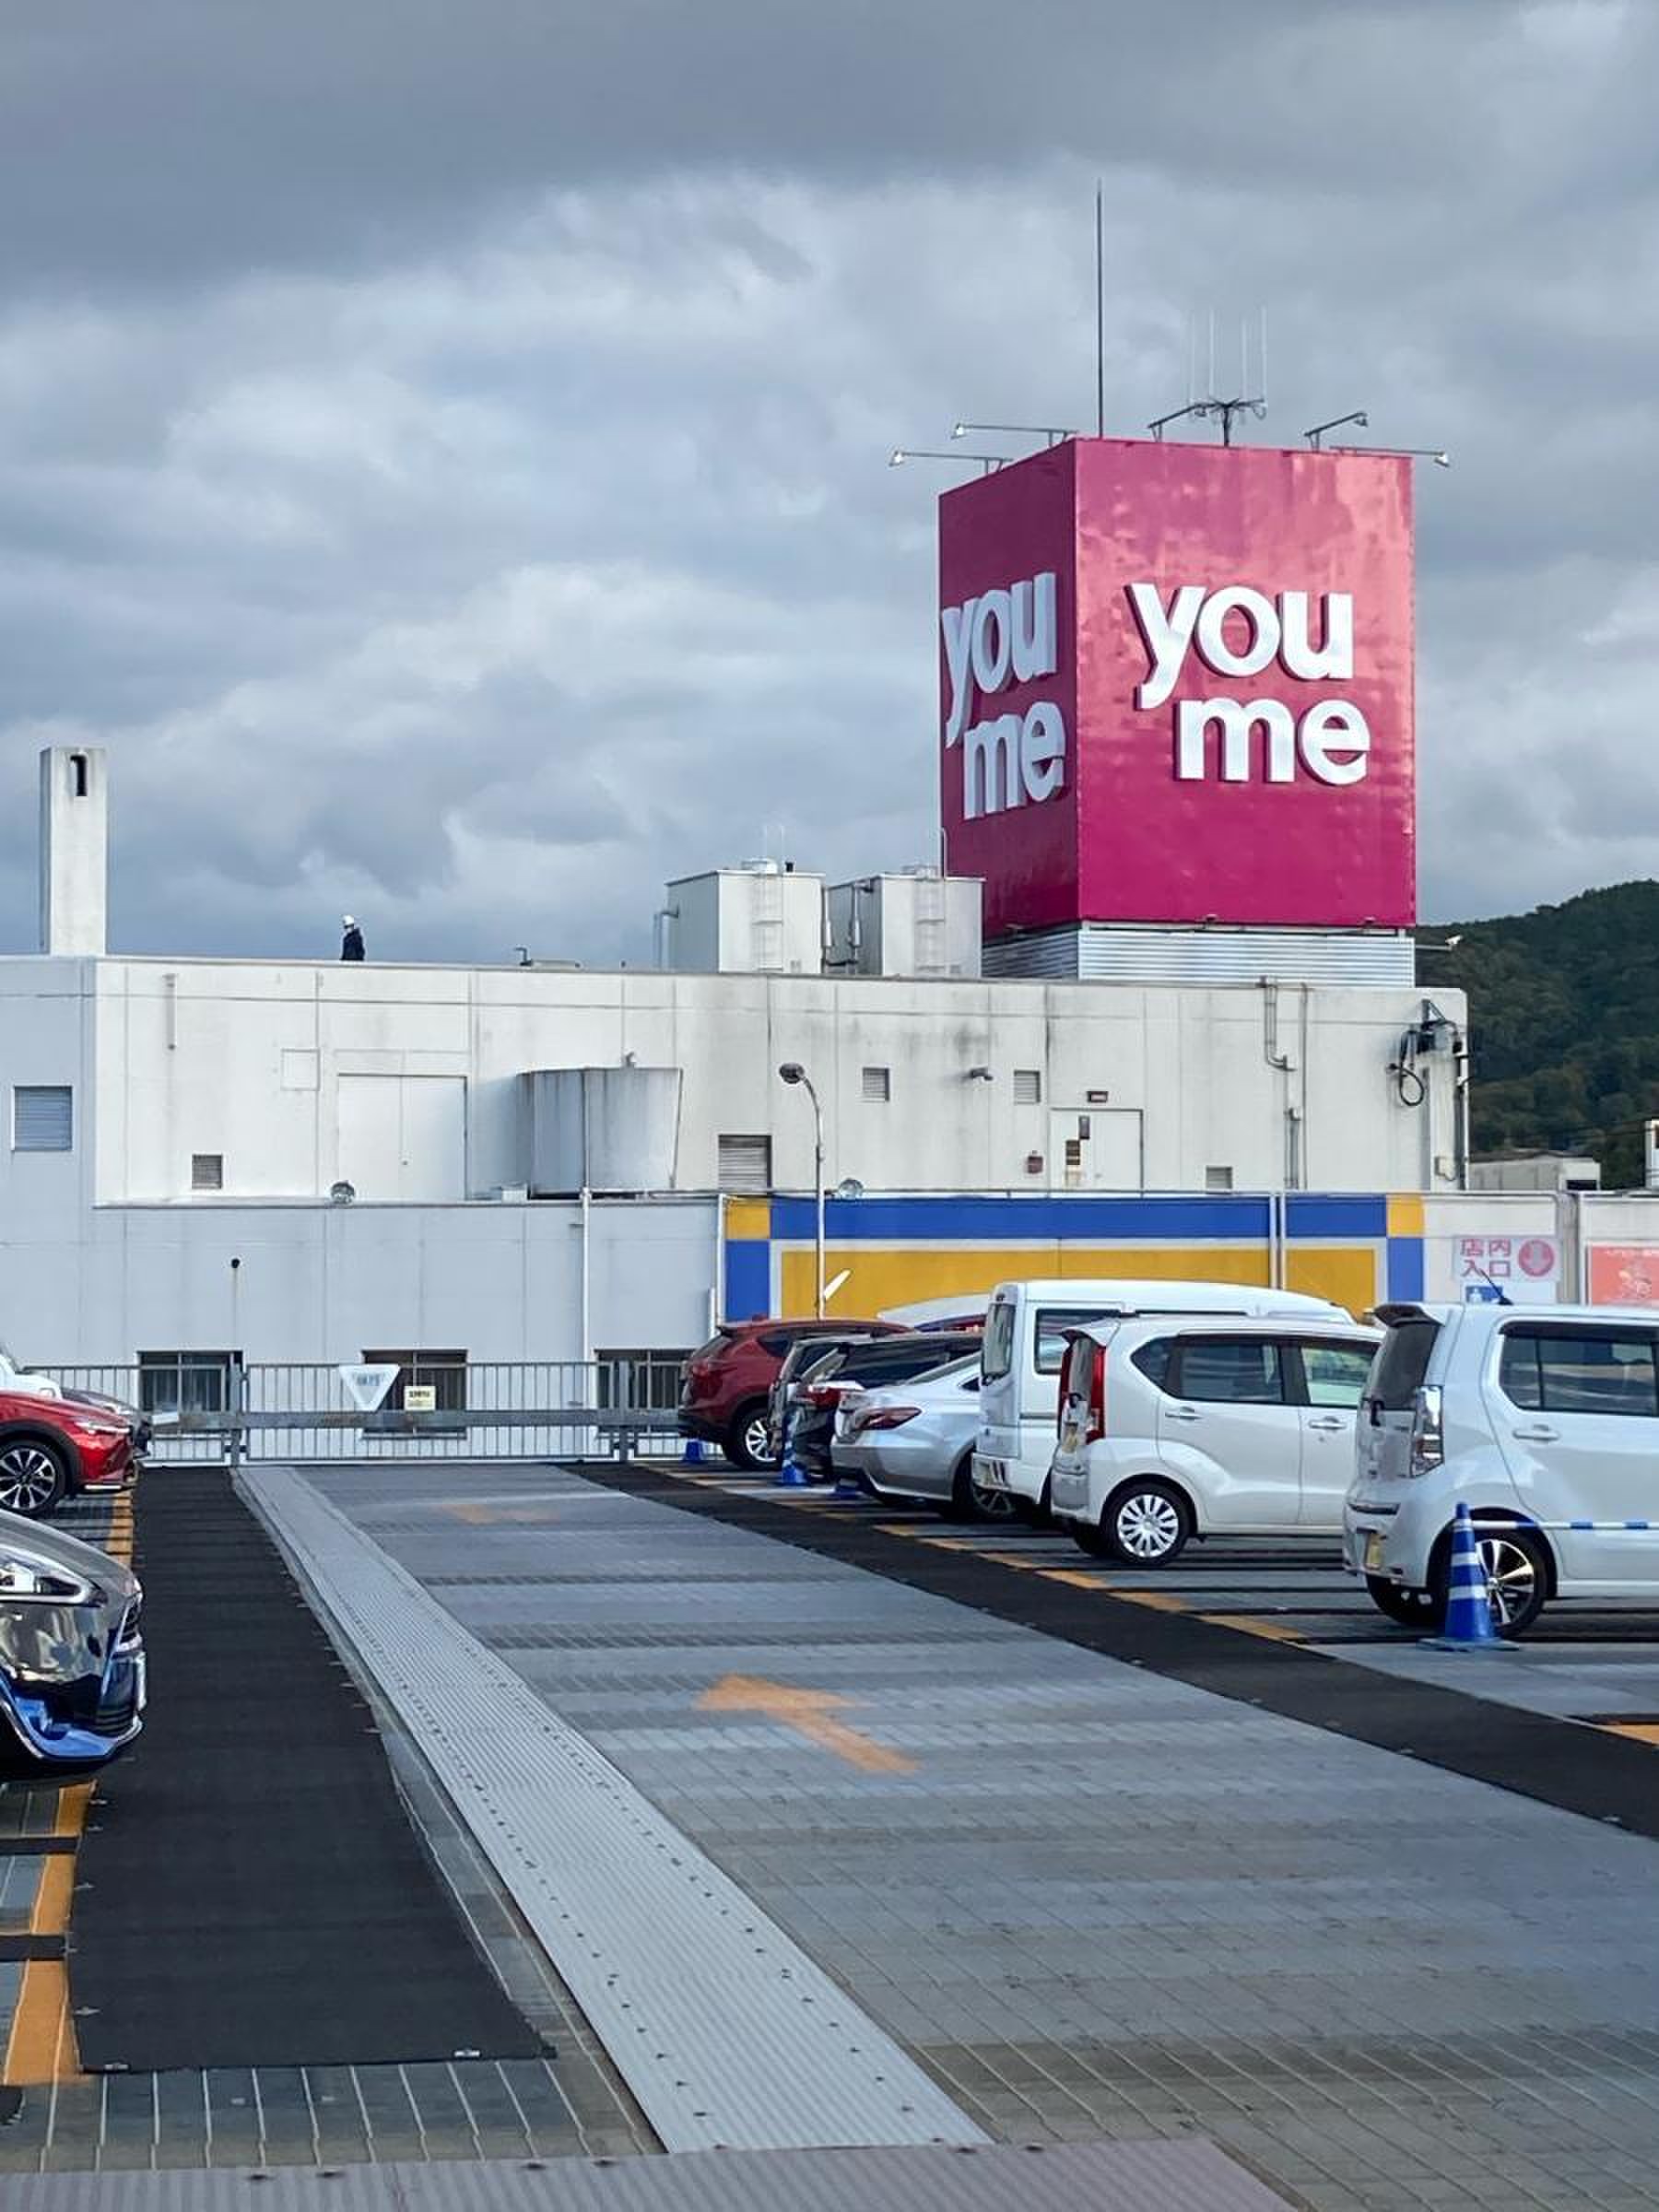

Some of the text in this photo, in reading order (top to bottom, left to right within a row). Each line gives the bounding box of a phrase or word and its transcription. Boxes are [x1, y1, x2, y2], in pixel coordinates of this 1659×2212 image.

[941, 572, 1056, 747] you
[1125, 582, 1353, 710] you
[964, 701, 1065, 819] me
[1174, 698, 1371, 785] me
[1461, 1239, 1512, 1256] 店内
[1462, 1260, 1511, 1277] 入口
